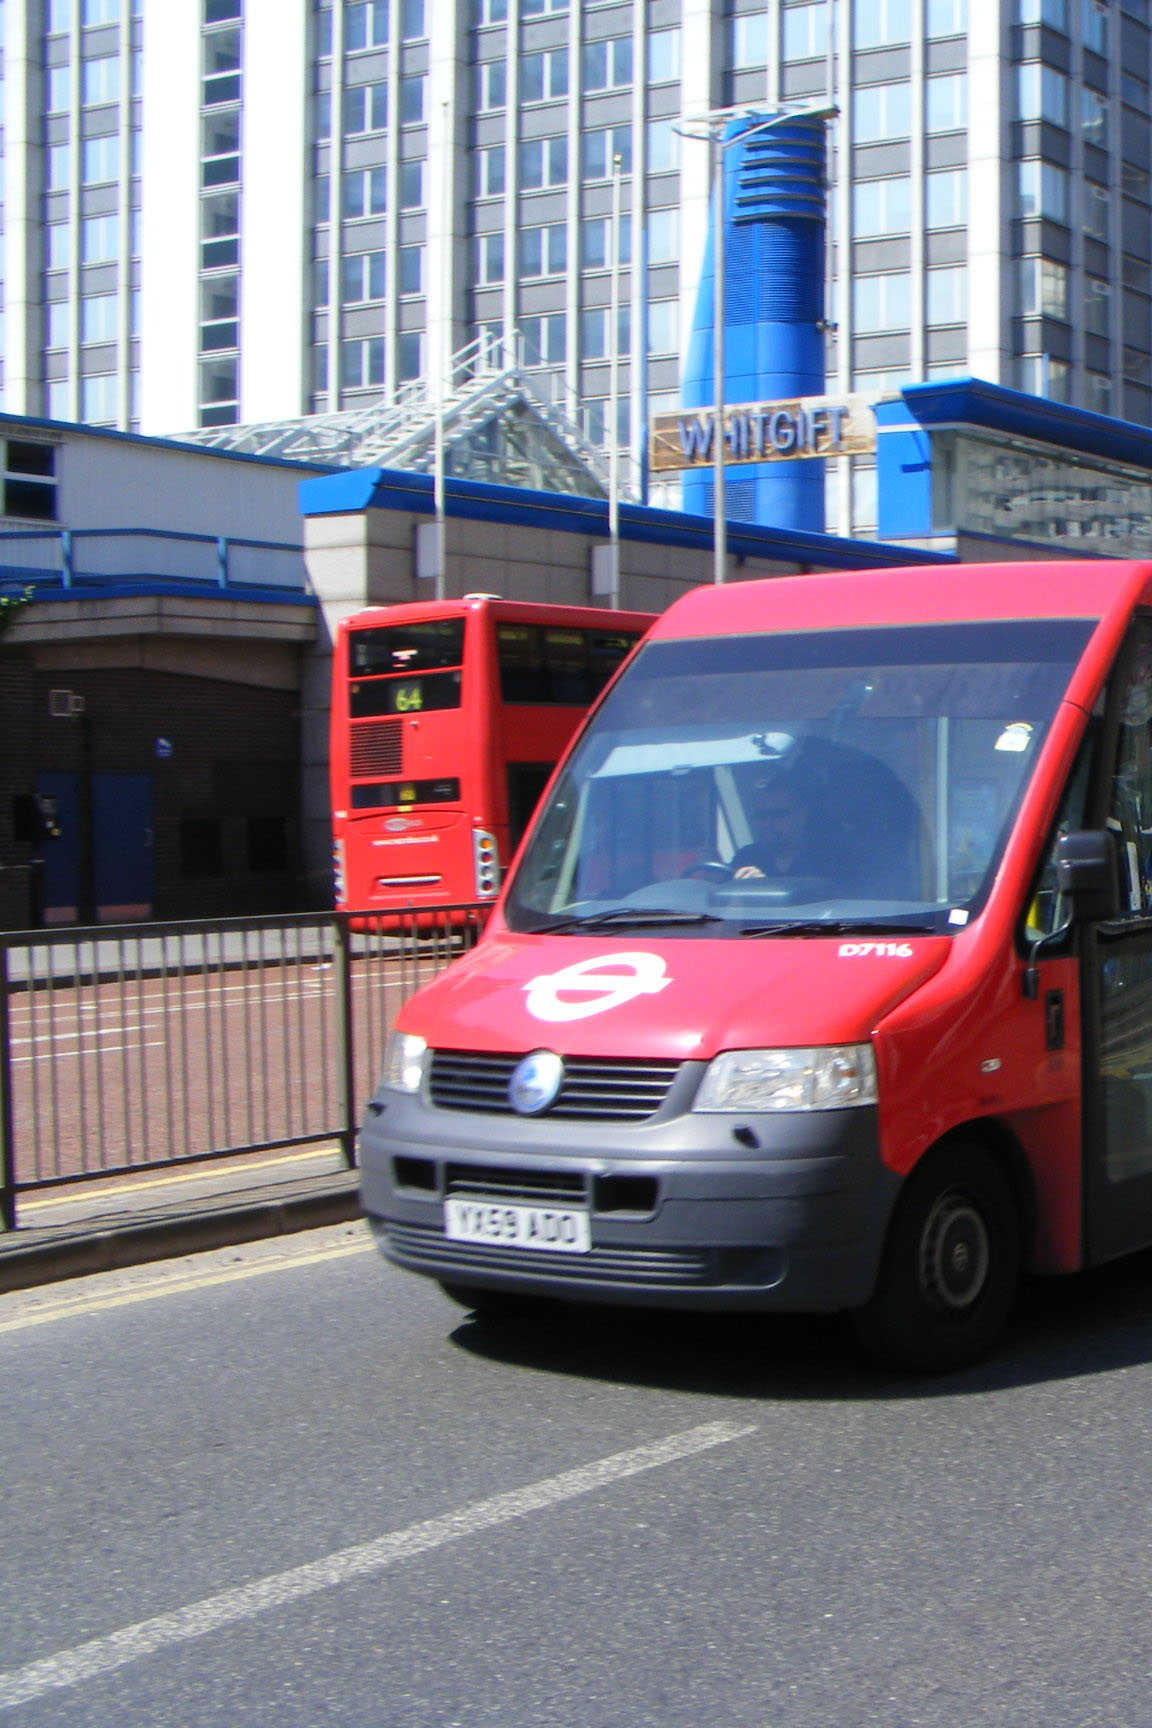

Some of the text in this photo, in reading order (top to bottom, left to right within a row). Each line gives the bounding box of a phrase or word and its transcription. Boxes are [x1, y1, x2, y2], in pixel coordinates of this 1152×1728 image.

[677, 405, 847, 462] WHITGIFT
[396, 688, 423, 712] 64
[838, 942, 914, 958] D7116
